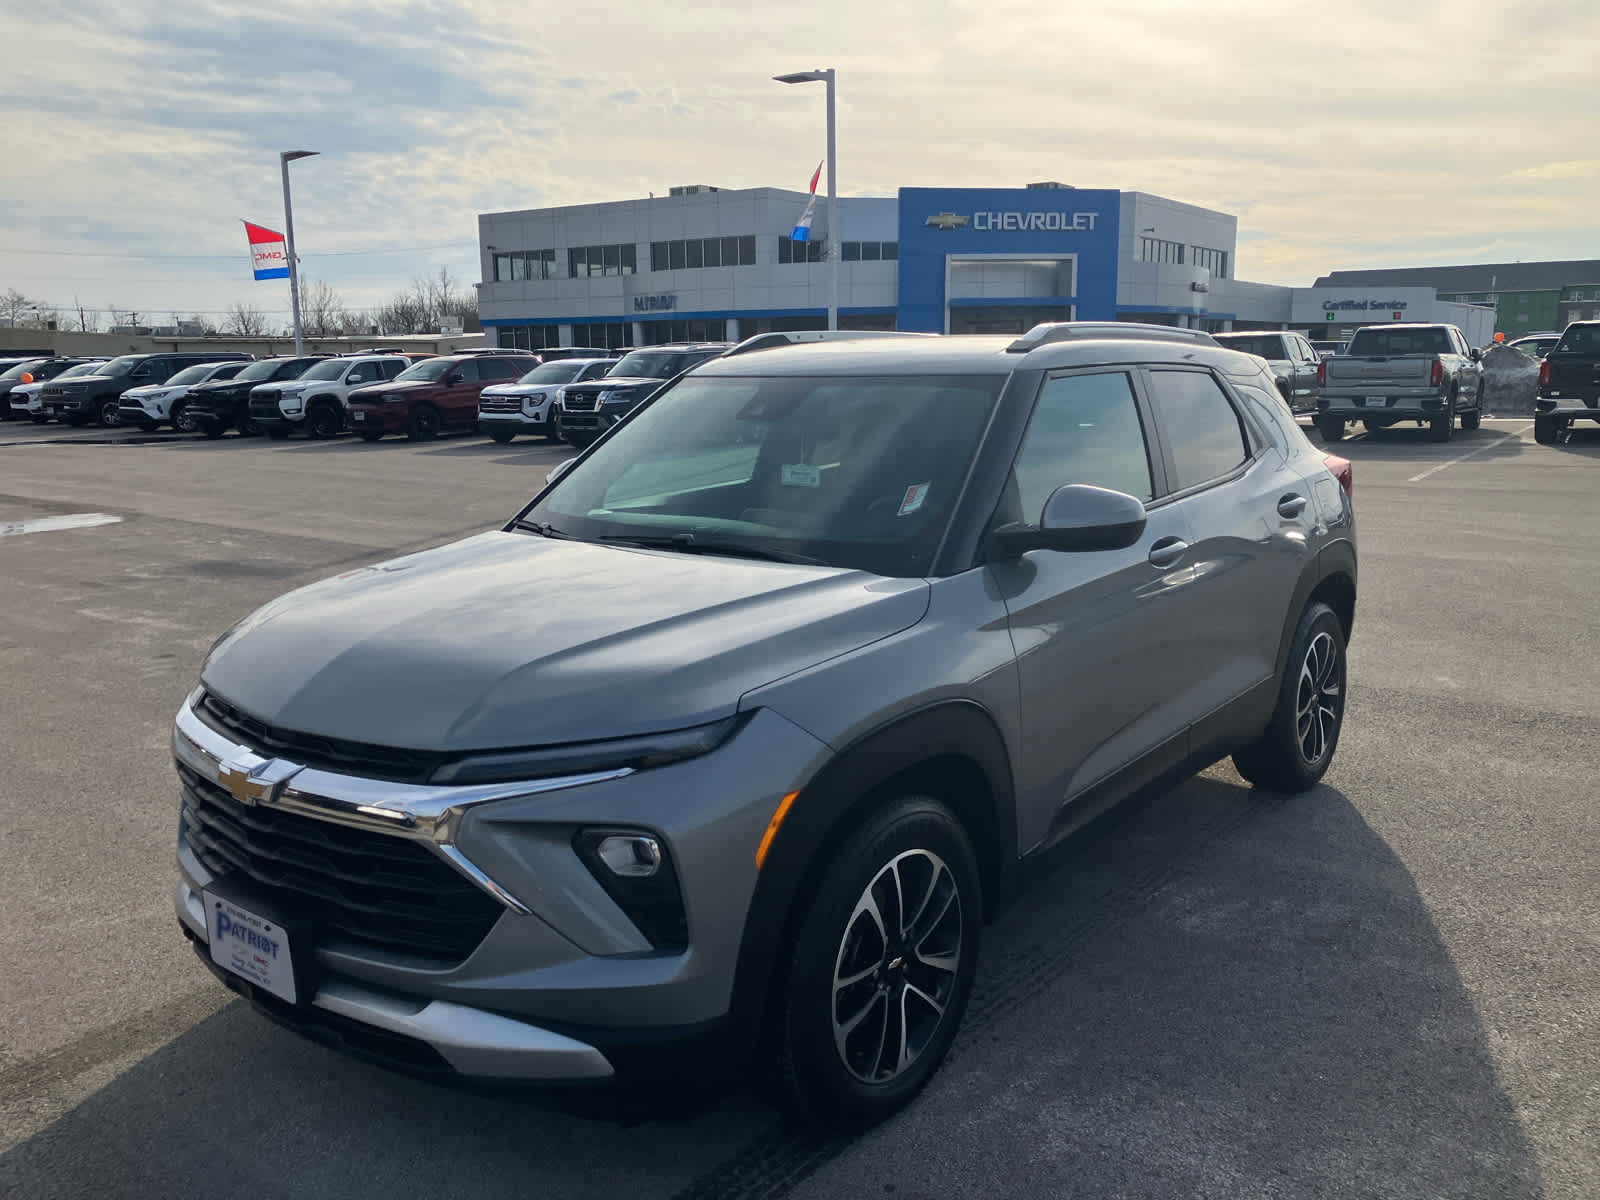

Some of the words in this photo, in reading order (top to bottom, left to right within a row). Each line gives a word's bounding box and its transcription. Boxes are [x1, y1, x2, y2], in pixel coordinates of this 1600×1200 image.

[974, 212, 1099, 230] CHEVROLET
[1323, 301, 1368, 311] Certified
[1370, 301, 1407, 311] Service
[216, 911, 280, 960] PATRIOT
